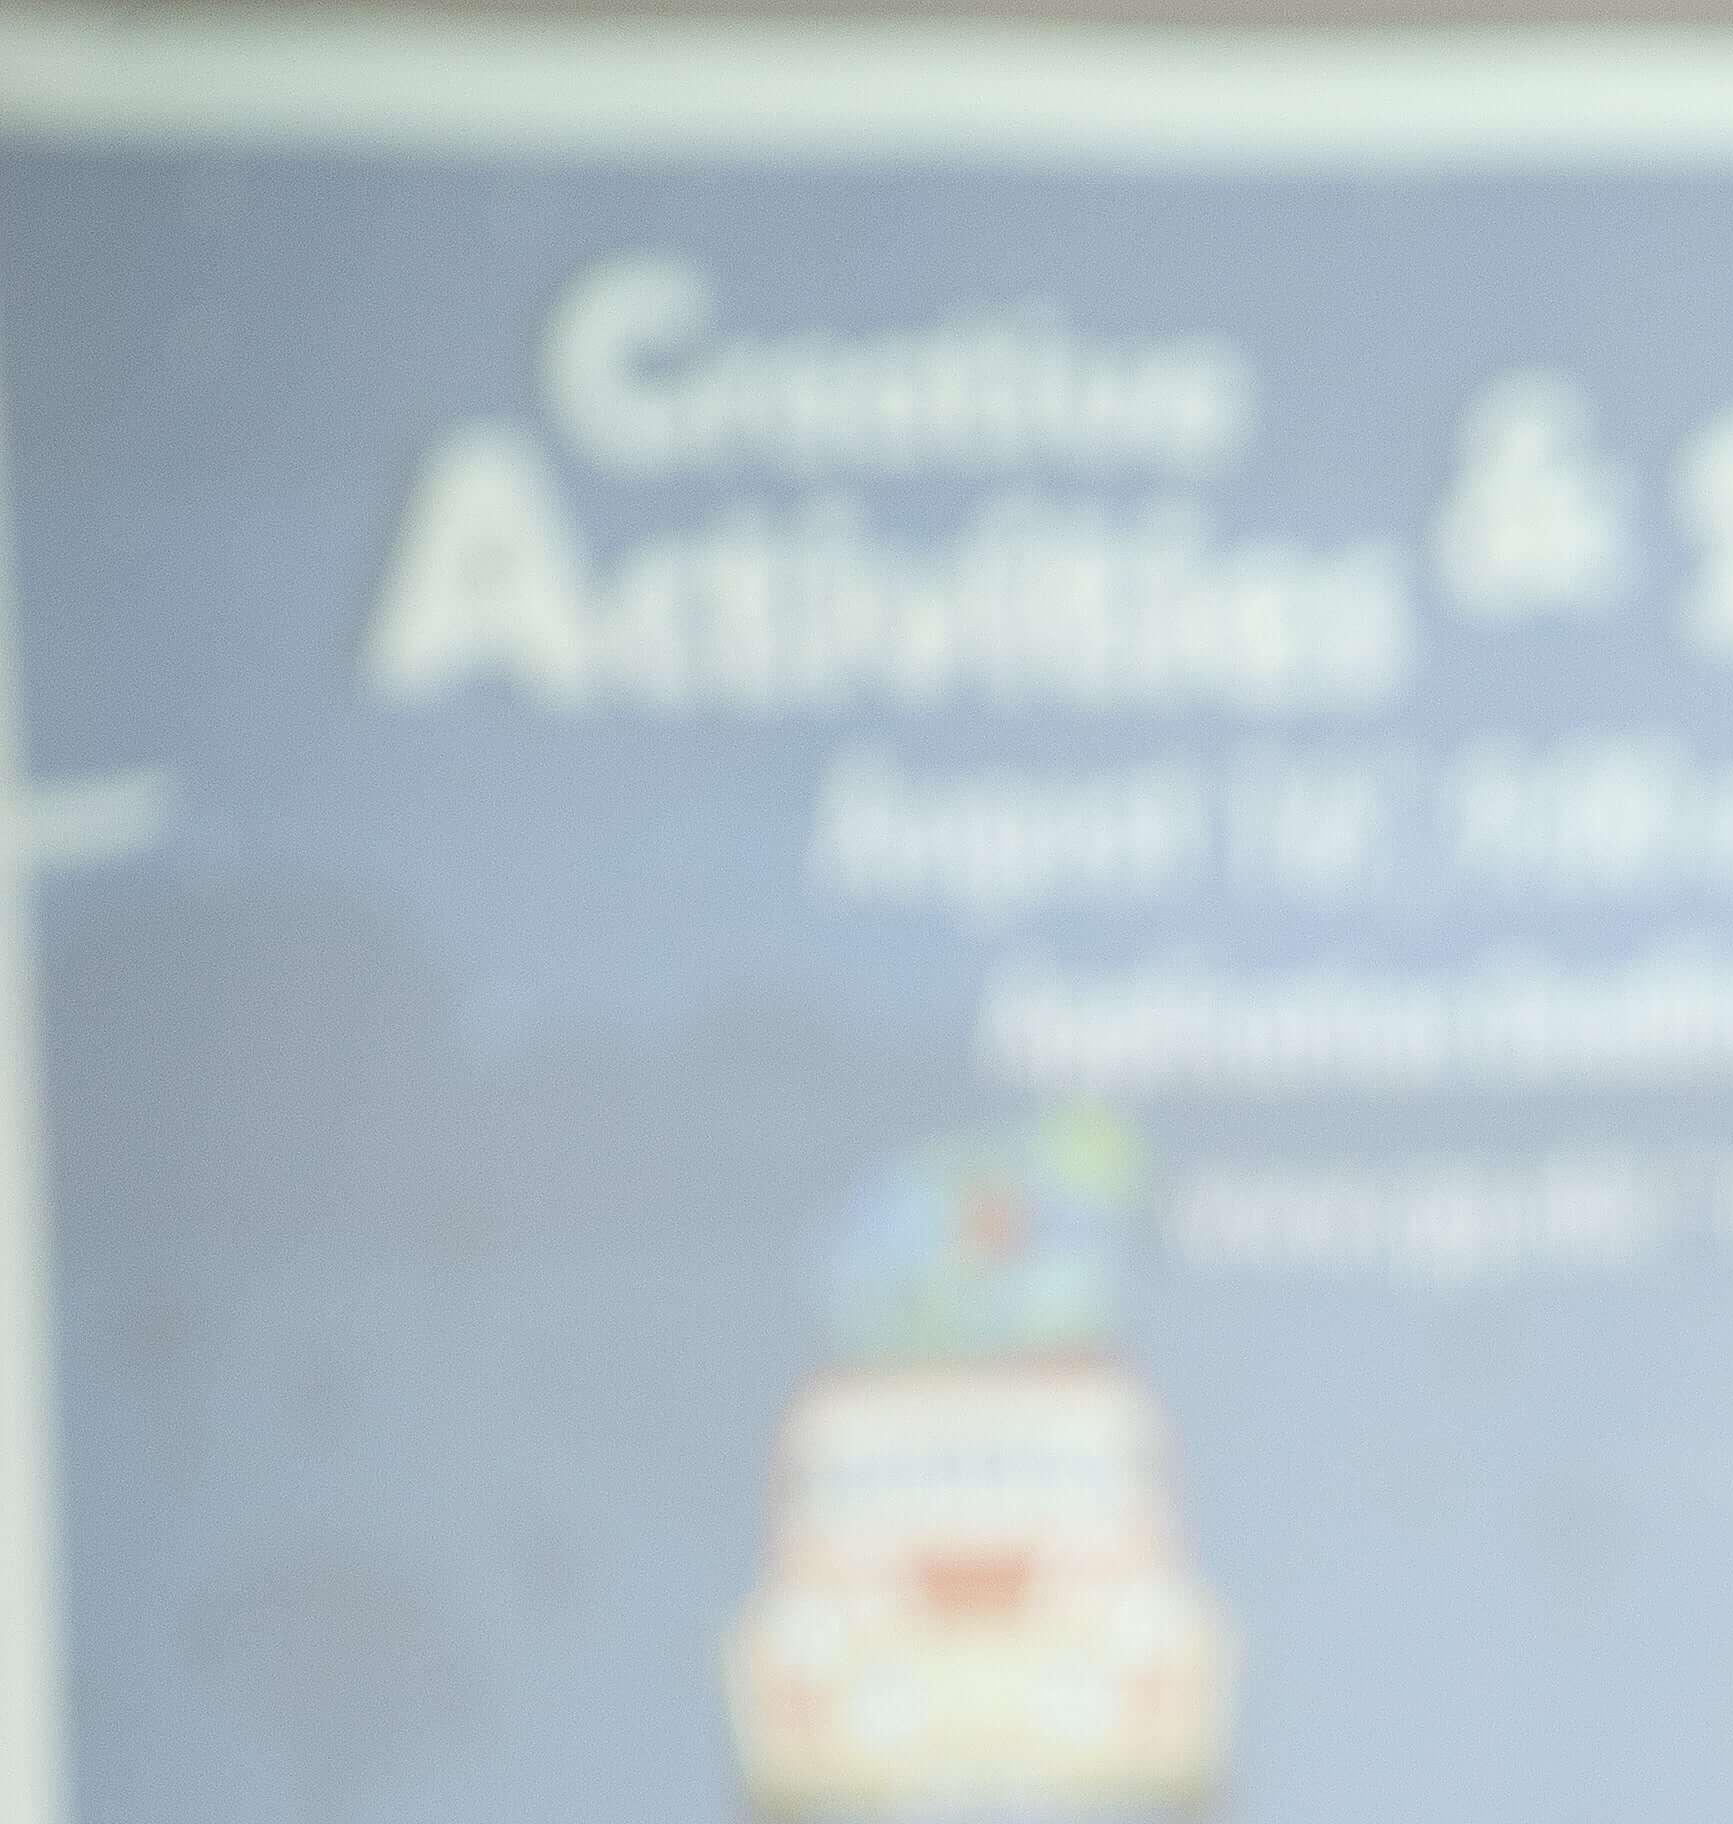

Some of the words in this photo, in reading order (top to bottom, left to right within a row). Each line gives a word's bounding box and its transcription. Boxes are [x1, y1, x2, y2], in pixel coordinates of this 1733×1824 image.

[557, 264, 1240, 464] Creative
[377, 427, 1400, 698] Activities
[1447, 384, 1610, 606] &
